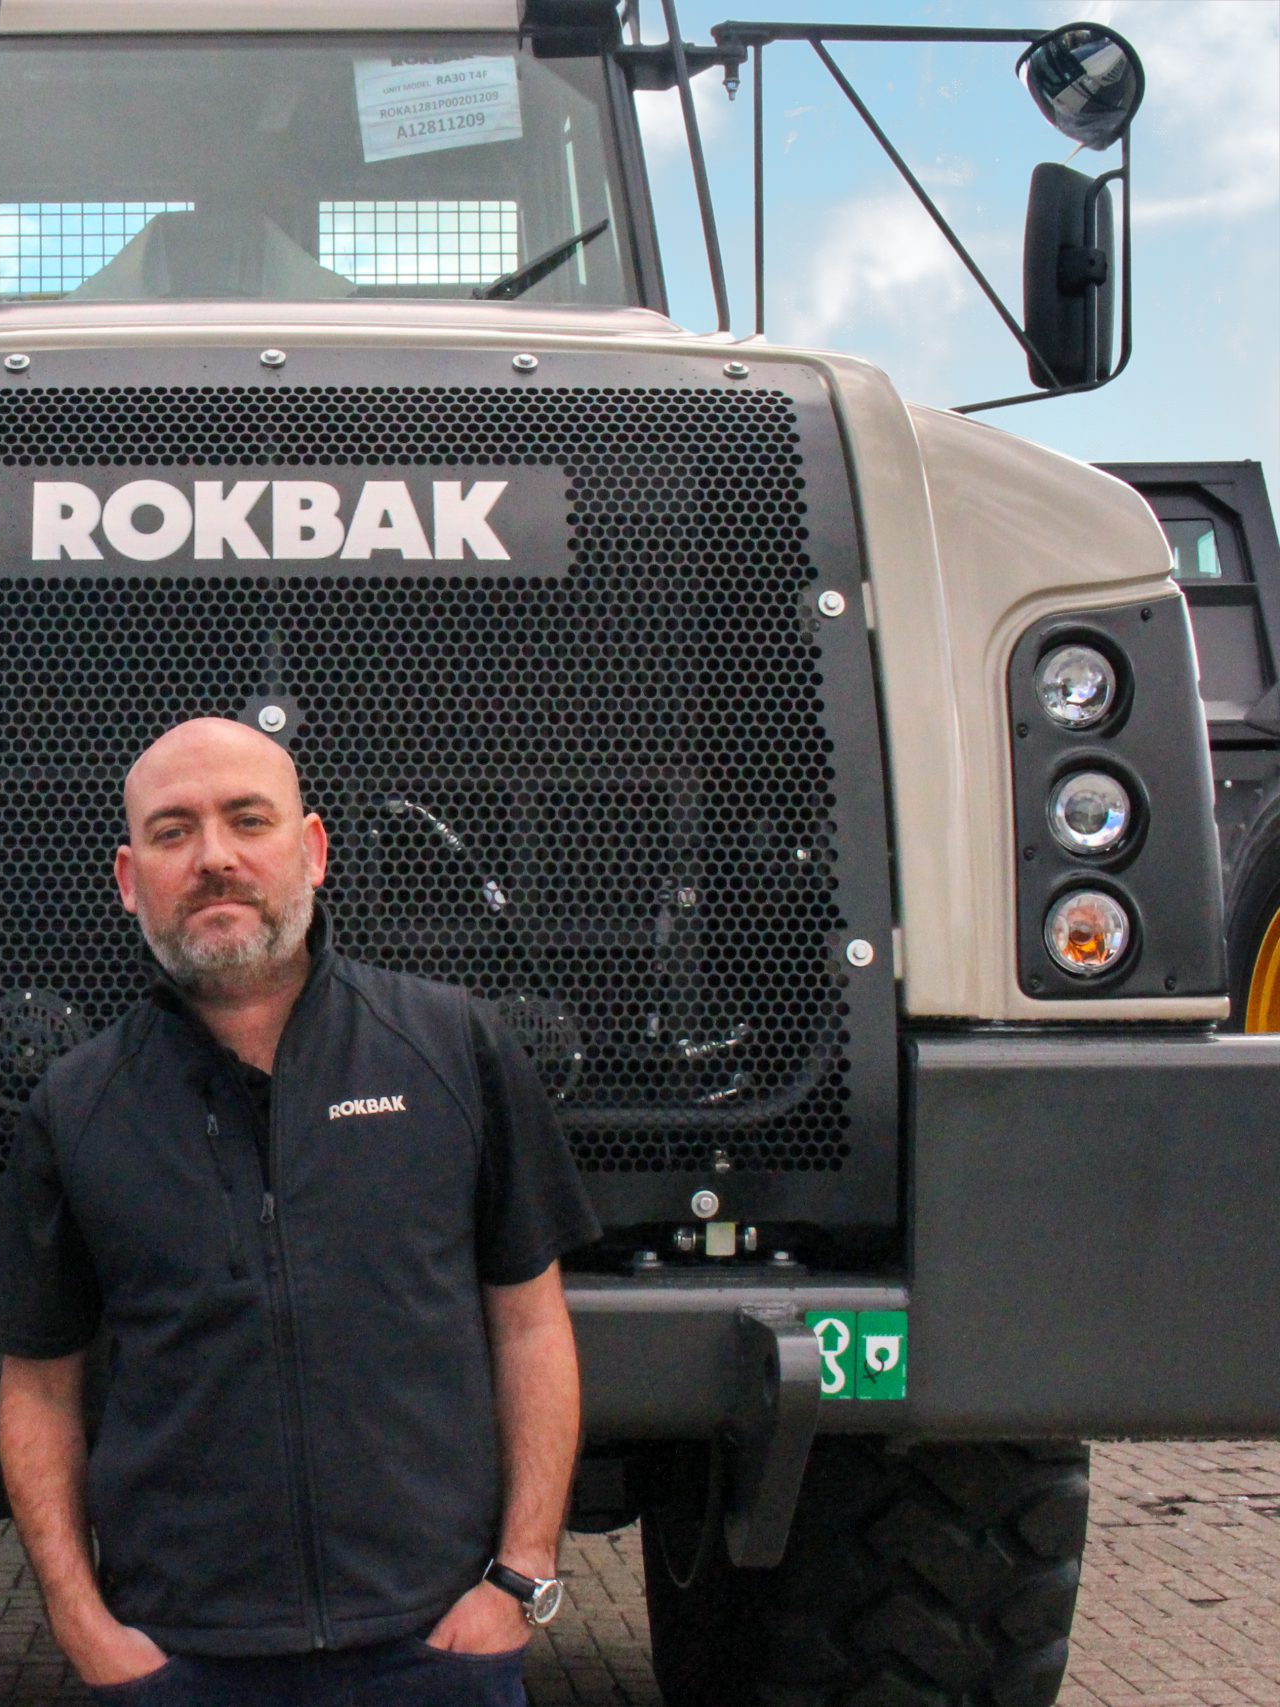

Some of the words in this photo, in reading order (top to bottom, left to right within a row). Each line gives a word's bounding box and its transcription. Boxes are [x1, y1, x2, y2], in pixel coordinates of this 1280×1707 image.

[382, 86, 401, 94] UNIT
[436, 72, 466, 85] RA30
[468, 70, 488, 80] T4F
[379, 91, 499, 119] ROKA1281P00201209
[396, 112, 485, 139] A12811209
[31, 479, 511, 561] ROKBAK
[328, 1095, 406, 1120] ROKBAK
